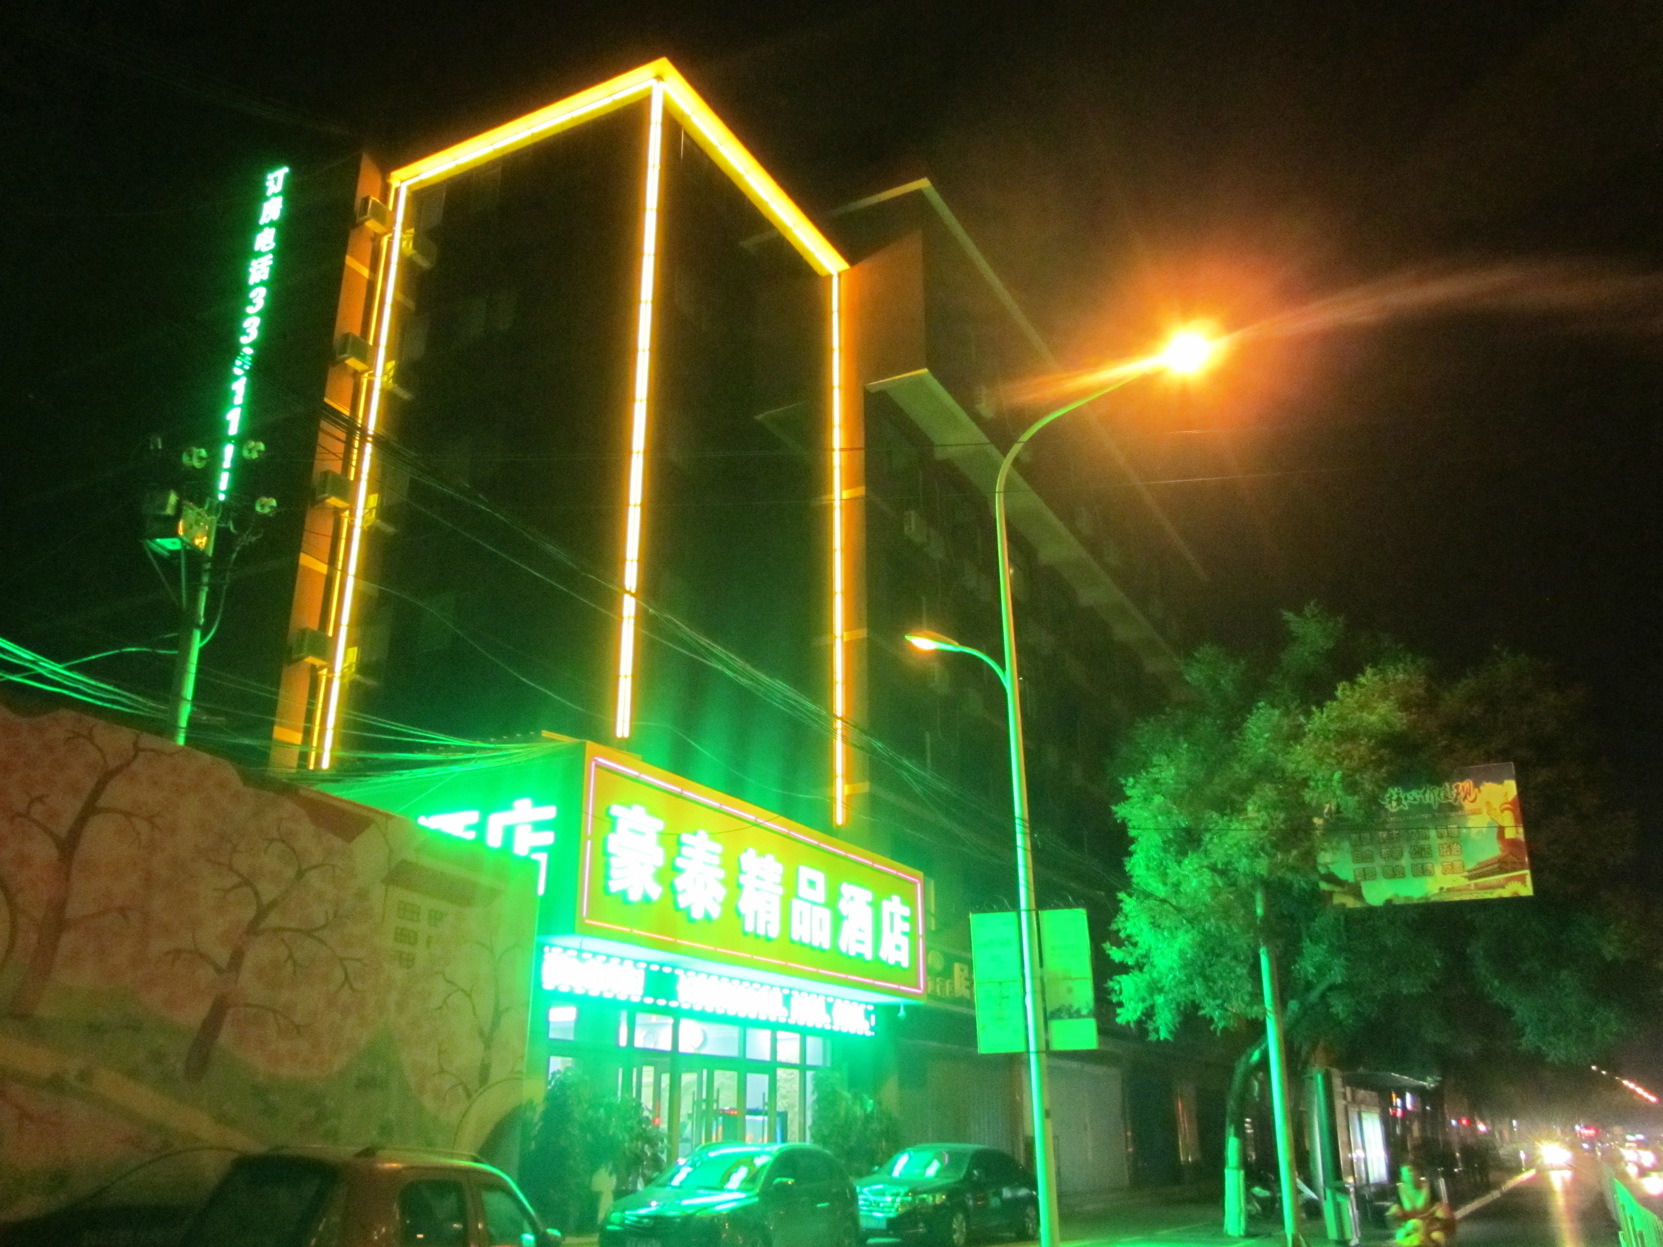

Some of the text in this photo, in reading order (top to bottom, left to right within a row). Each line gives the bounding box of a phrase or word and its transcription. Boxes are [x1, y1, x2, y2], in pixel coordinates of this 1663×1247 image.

[606, 803, 912, 969] 豪泰精品酒店
